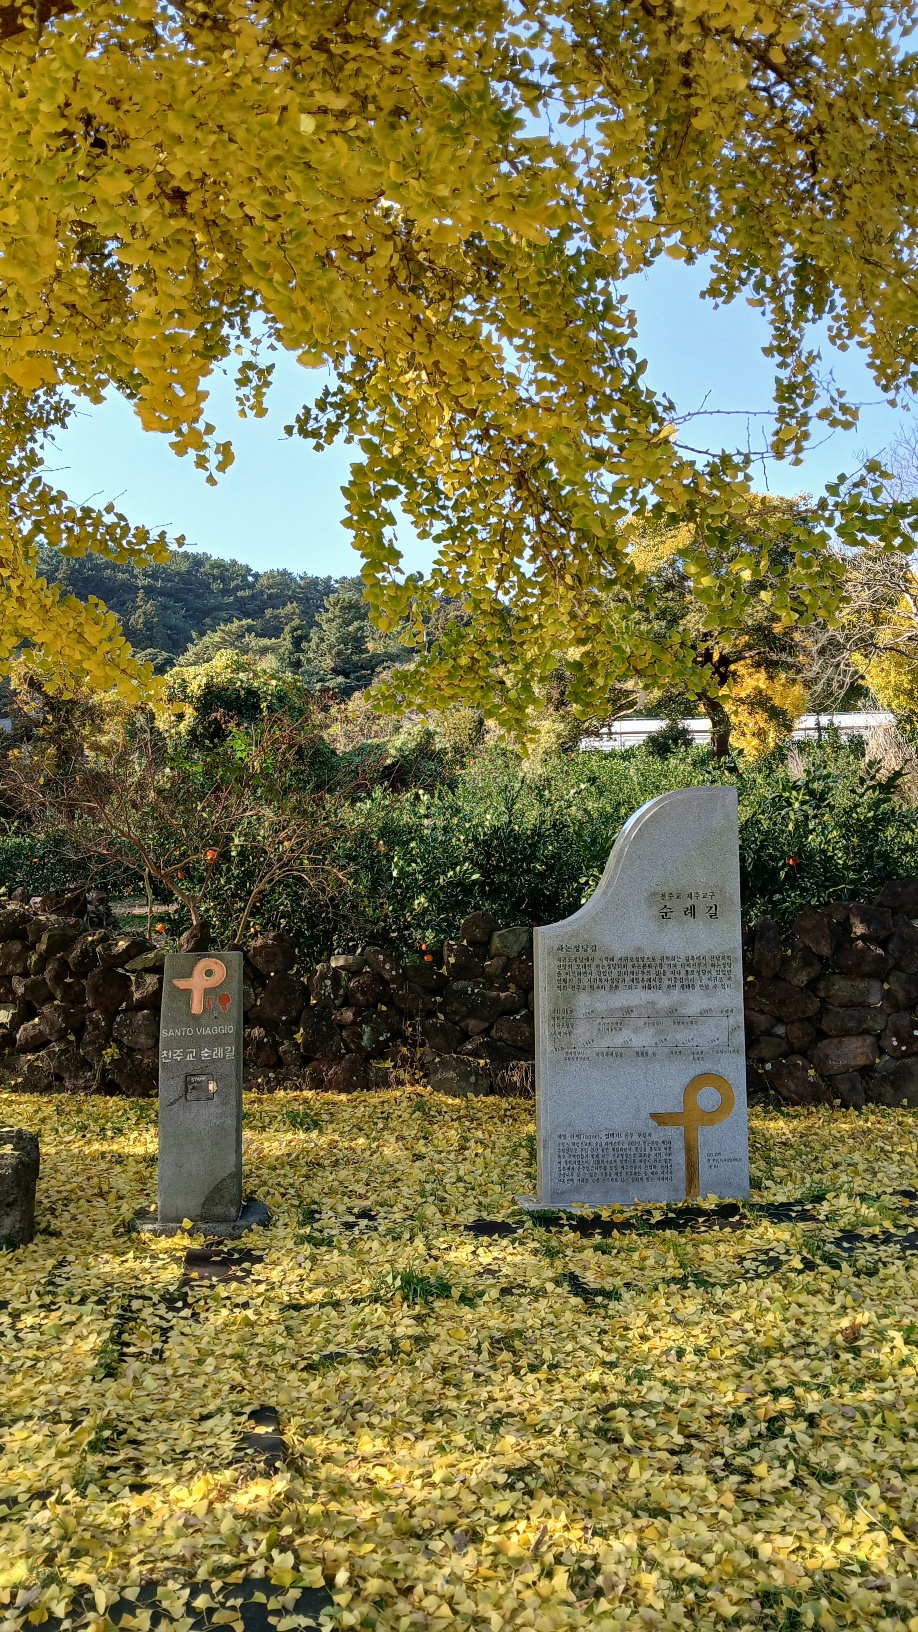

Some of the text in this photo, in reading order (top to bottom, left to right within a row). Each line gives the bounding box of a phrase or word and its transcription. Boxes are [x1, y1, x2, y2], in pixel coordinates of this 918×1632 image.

[658, 904, 719, 920] 순례길
[162, 1025, 234, 1038] SANTO VIAGGIO
[161, 1046, 236, 1063] 천주교 순례길
